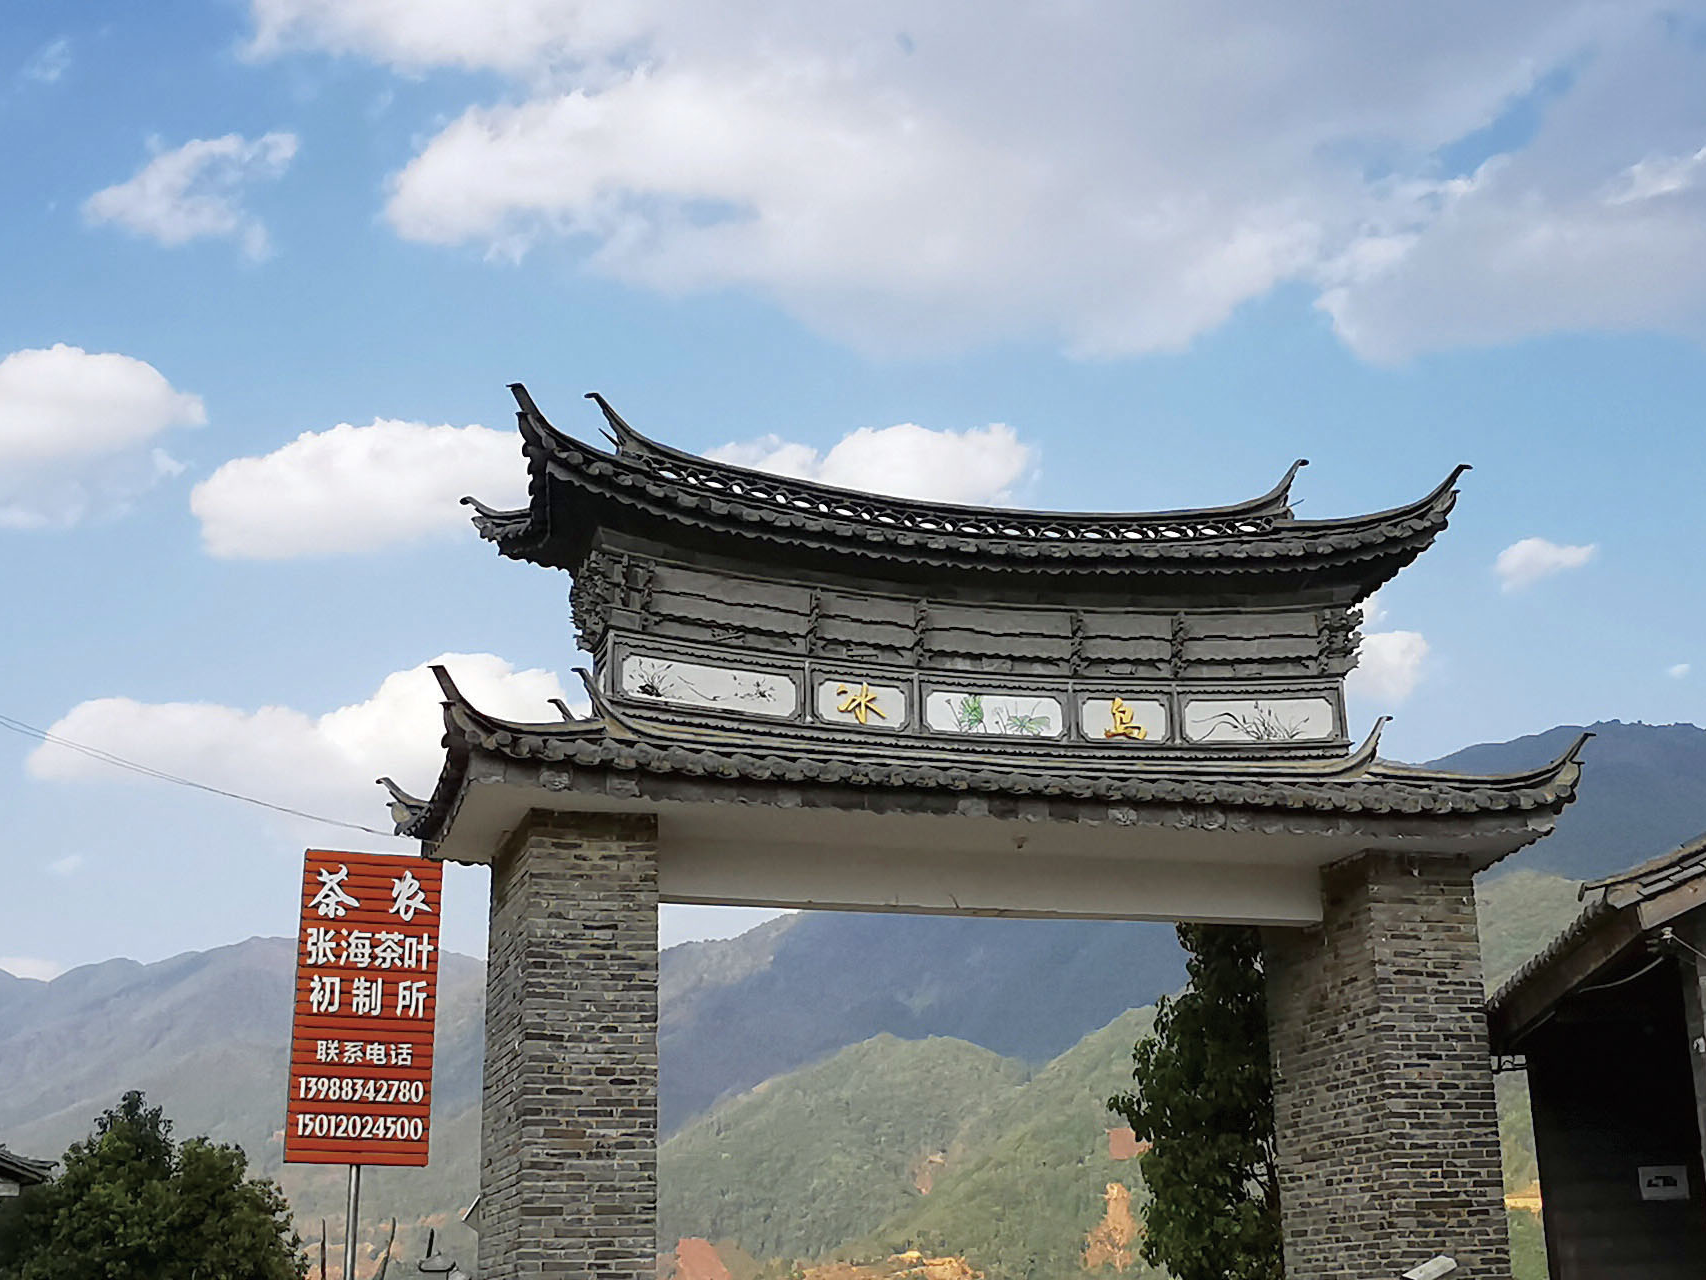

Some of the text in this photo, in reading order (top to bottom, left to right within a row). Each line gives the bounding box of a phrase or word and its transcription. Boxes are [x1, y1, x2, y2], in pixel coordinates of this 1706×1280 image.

[836, 680, 887, 726] 冰
[308, 864, 432, 921] 茶农
[306, 927, 434, 971] 张海茶叶
[309, 974, 428, 1018] 初制所
[316, 1039, 413, 1067] 联系电话
[298, 1076, 425, 1103] 13988342780
[296, 1113, 424, 1141] 15012024500
